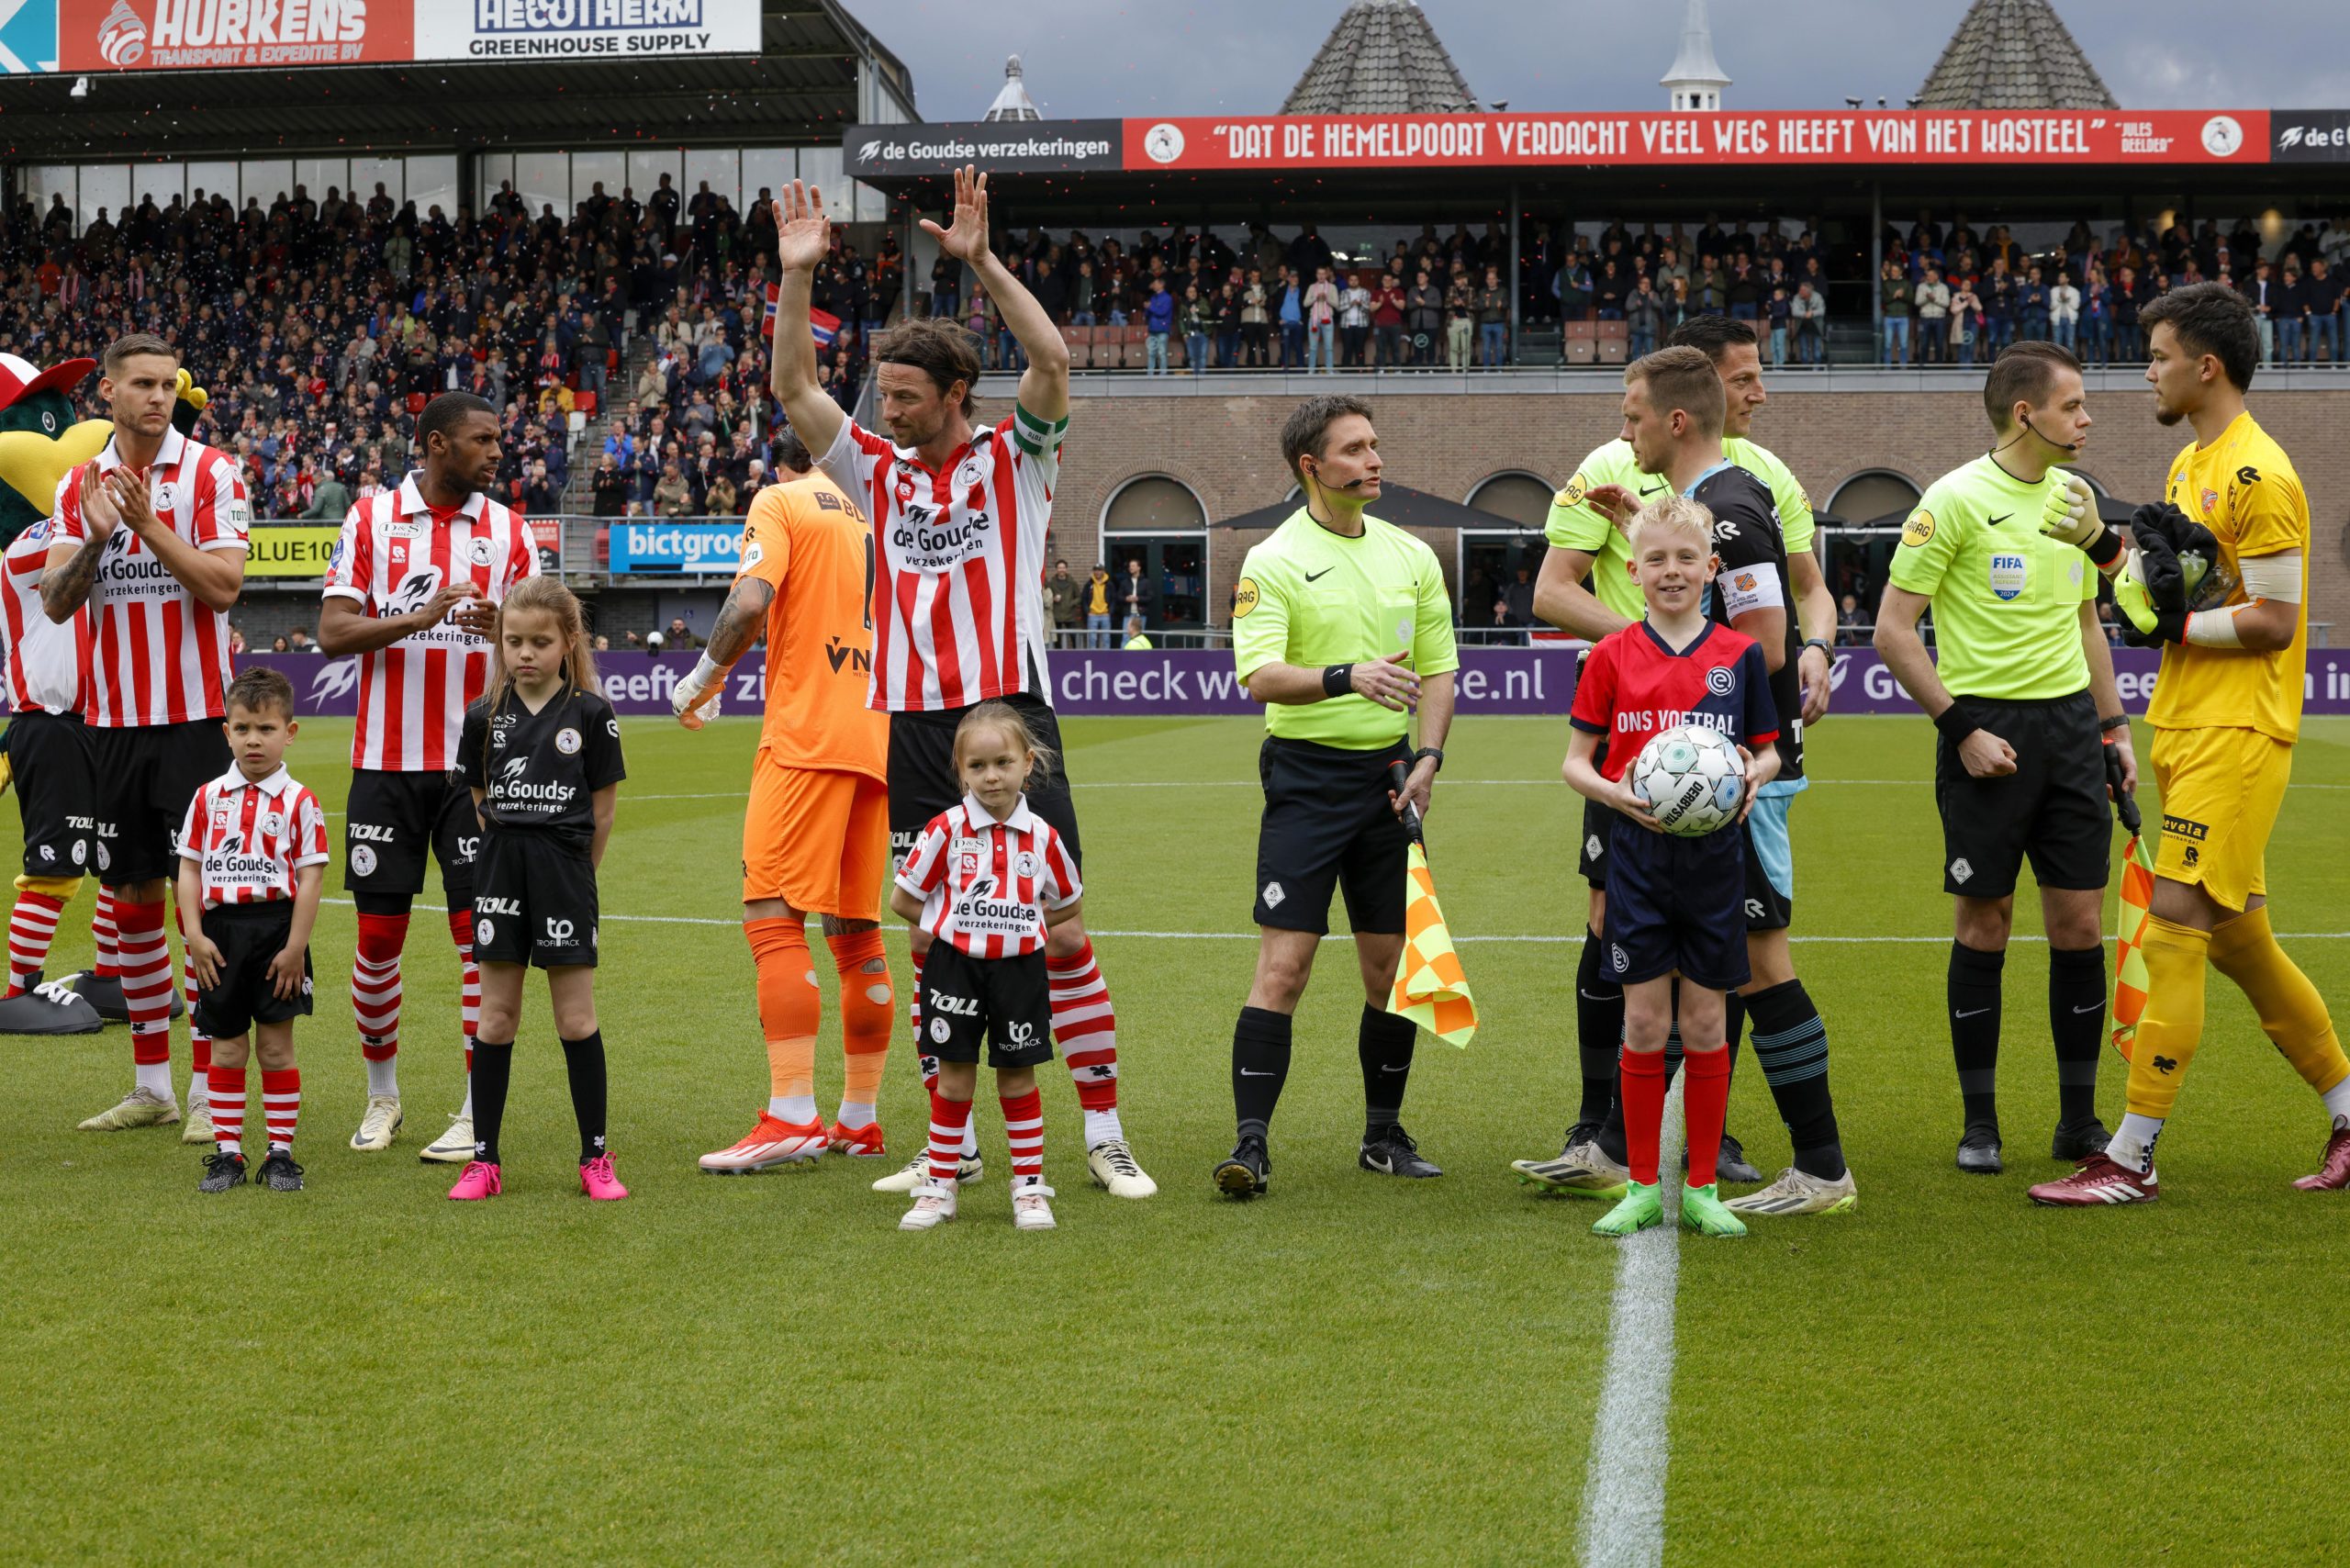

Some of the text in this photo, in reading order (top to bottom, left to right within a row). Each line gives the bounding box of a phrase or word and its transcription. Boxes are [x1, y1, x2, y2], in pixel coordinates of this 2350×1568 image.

[151, 0, 366, 46] HURKENS
[476, 0, 700, 30] HECOTHERM
[151, 43, 364, 66] TRANSPORT & EXPEDITIE BV
[469, 33, 711, 55] GREENHOUSE SUPPLY
[1285, 124, 1315, 158] DE
[1324, 122, 1486, 157] HEMELPOORT
[1496, 121, 1630, 156] VERDACHT
[1639, 120, 1704, 154] VEEL
[1713, 119, 1769, 153] WEG
[1778, 119, 1854, 153] HEEFT
[1864, 118, 1917, 153] VAN
[1926, 118, 1972, 152] HET
[2305, 129, 2329, 147] de
[882, 138, 1110, 160] de Goudse verzekeringen
[1564, 485, 1582, 499] AG
[1906, 520, 1930, 537] ARAG
[1993, 557, 2023, 569] FIFA
[105, 583, 181, 598] erzekeringen
[1237, 590, 1255, 604] RAG
[1062, 659, 1189, 700] check
[1617, 710, 1652, 734] ONS
[349, 823, 395, 844] TOLL
[2164, 819, 2202, 837] evela
[955, 839, 985, 849] D&S
[206, 856, 222, 872] de
[476, 896, 521, 916] TOLL
[974, 900, 1035, 922] Goudse
[930, 988, 979, 1016] TOLL
